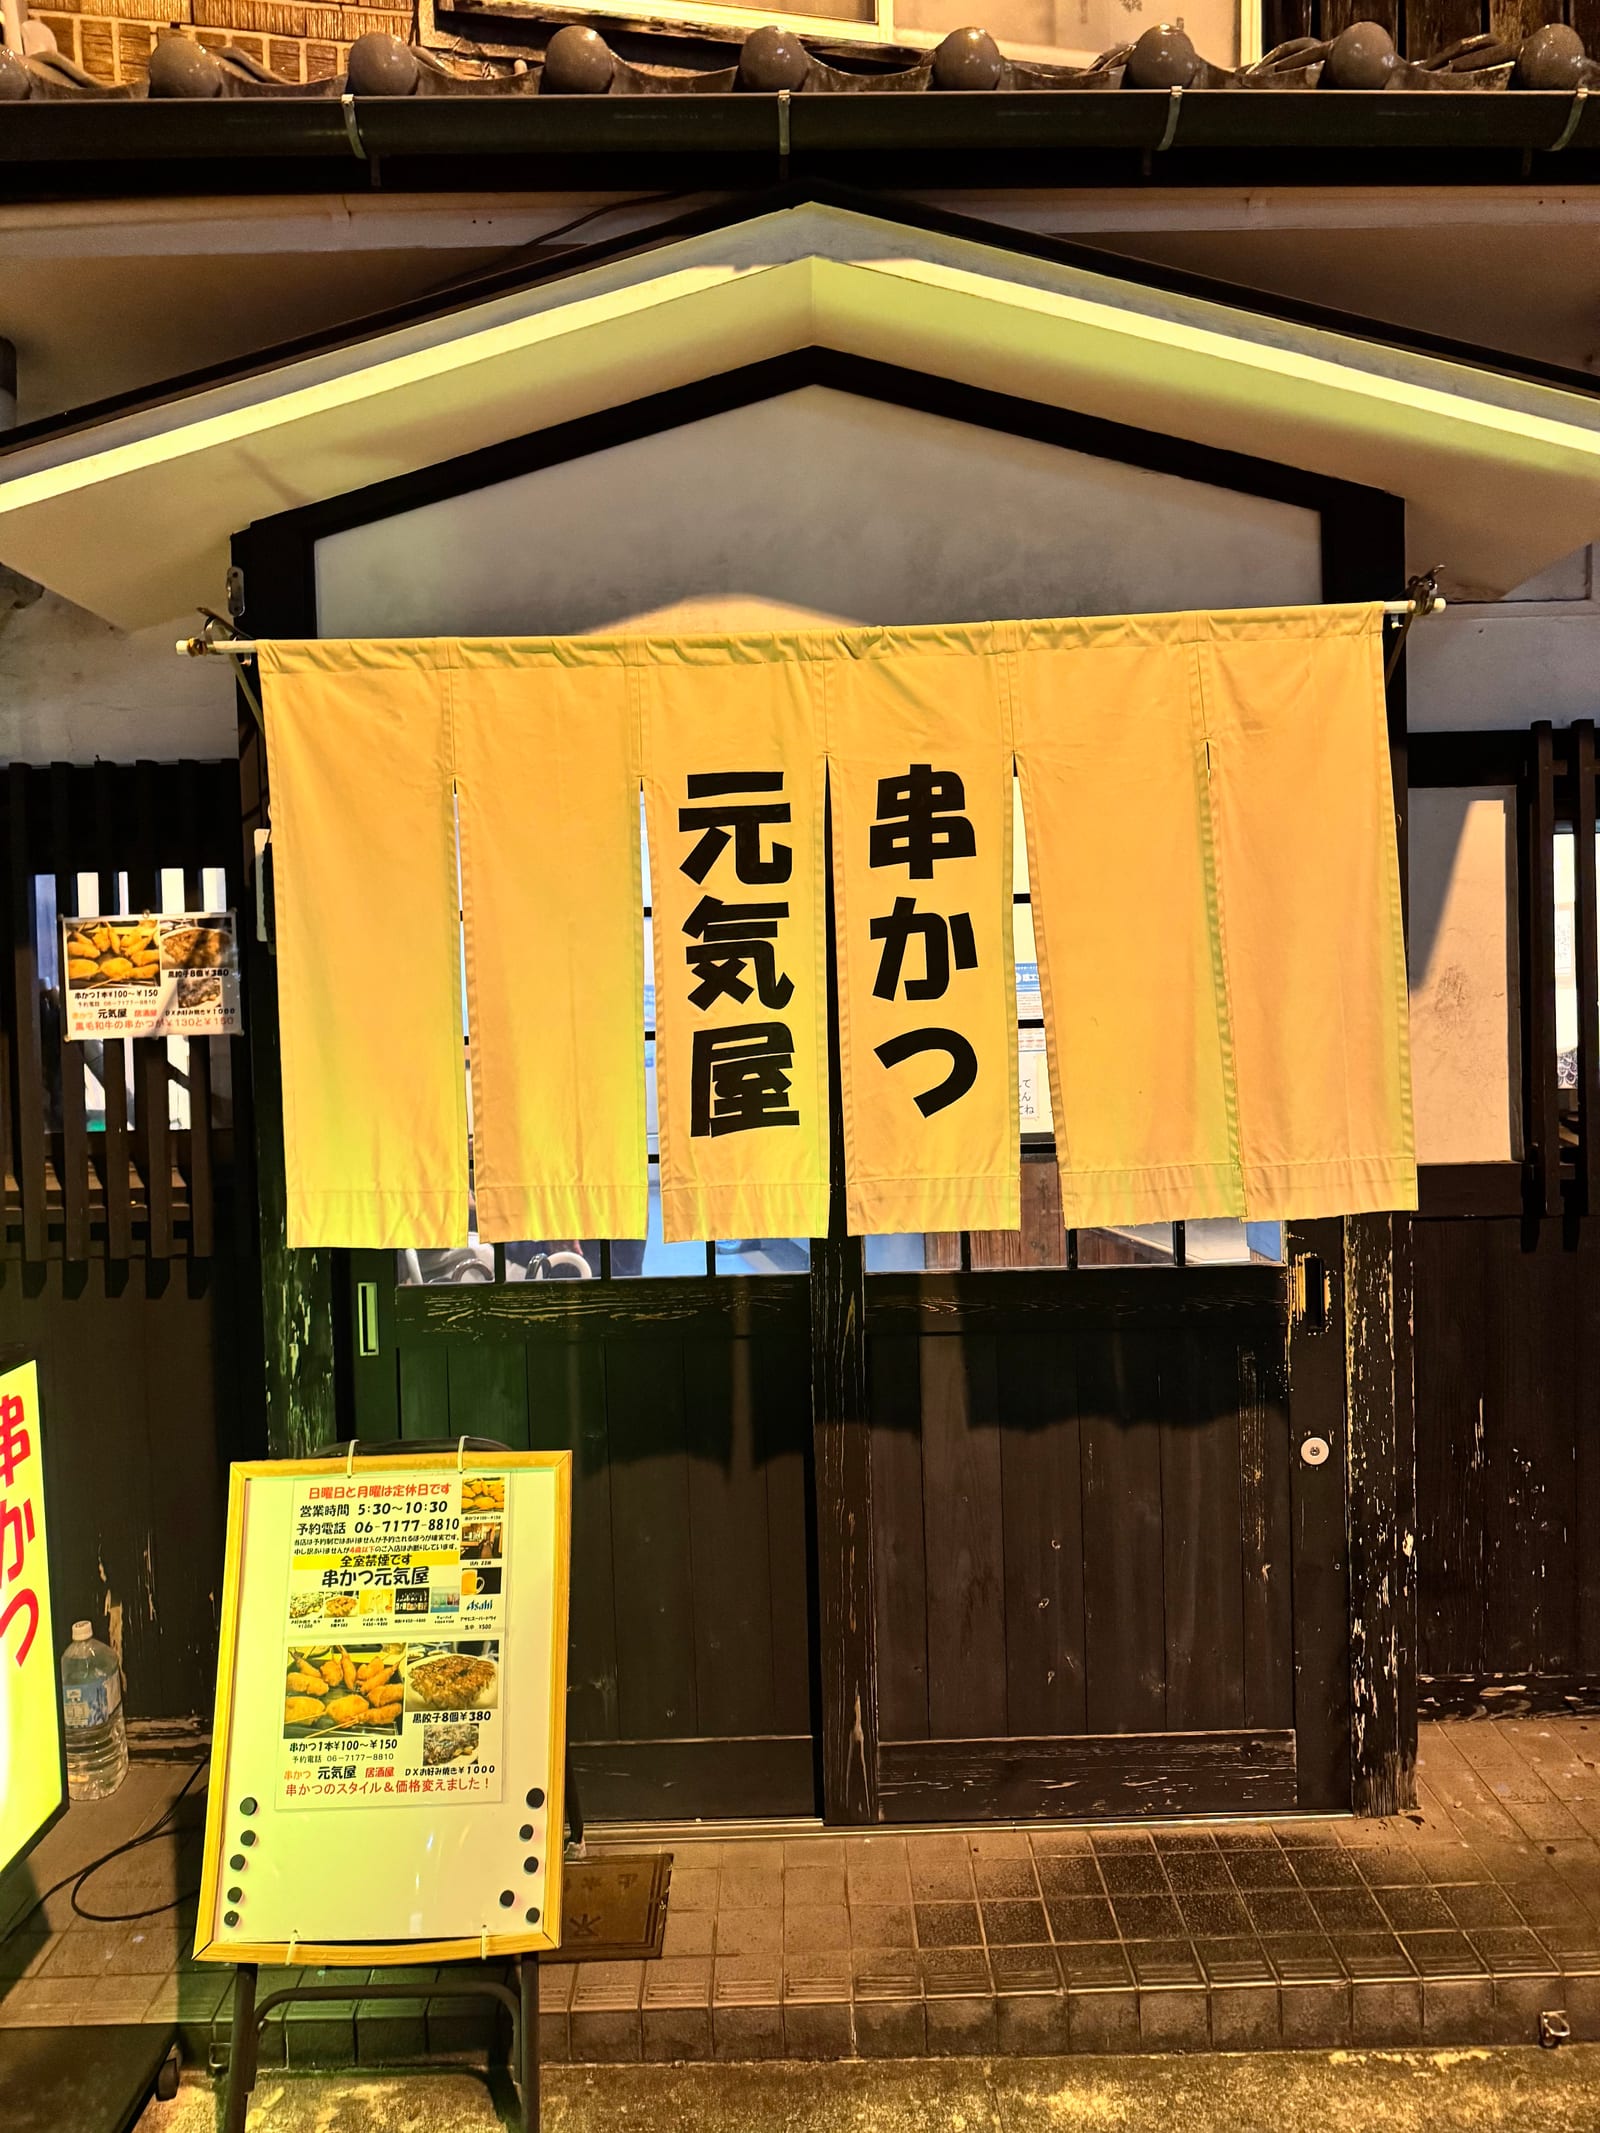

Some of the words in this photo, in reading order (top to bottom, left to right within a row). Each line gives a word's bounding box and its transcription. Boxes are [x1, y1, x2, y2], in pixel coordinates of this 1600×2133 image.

[870, 764, 978, 1119] 串かつ
[679, 771, 801, 1138] 元気屋
[98, 1008, 127, 1019] 元気屋
[309, 1482, 452, 1500] 日曜日と月曜は定休日です
[300, 1503, 350, 1518] 営業時間
[296, 1521, 347, 1536] 予約電話
[354, 1518, 460, 1534] 06-7177-8810
[340, 1553, 413, 1568] 全室禁煙です
[322, 1566, 430, 1588] 串かつ元気屋
[466, 1599, 493, 1611] Asahi
[292, 1755, 322, 1764] 予約電話
[283, 1770, 311, 1781] 串かつ
[317, 1764, 357, 1780] 元気屋
[364, 1766, 395, 1778] 居酒屋
